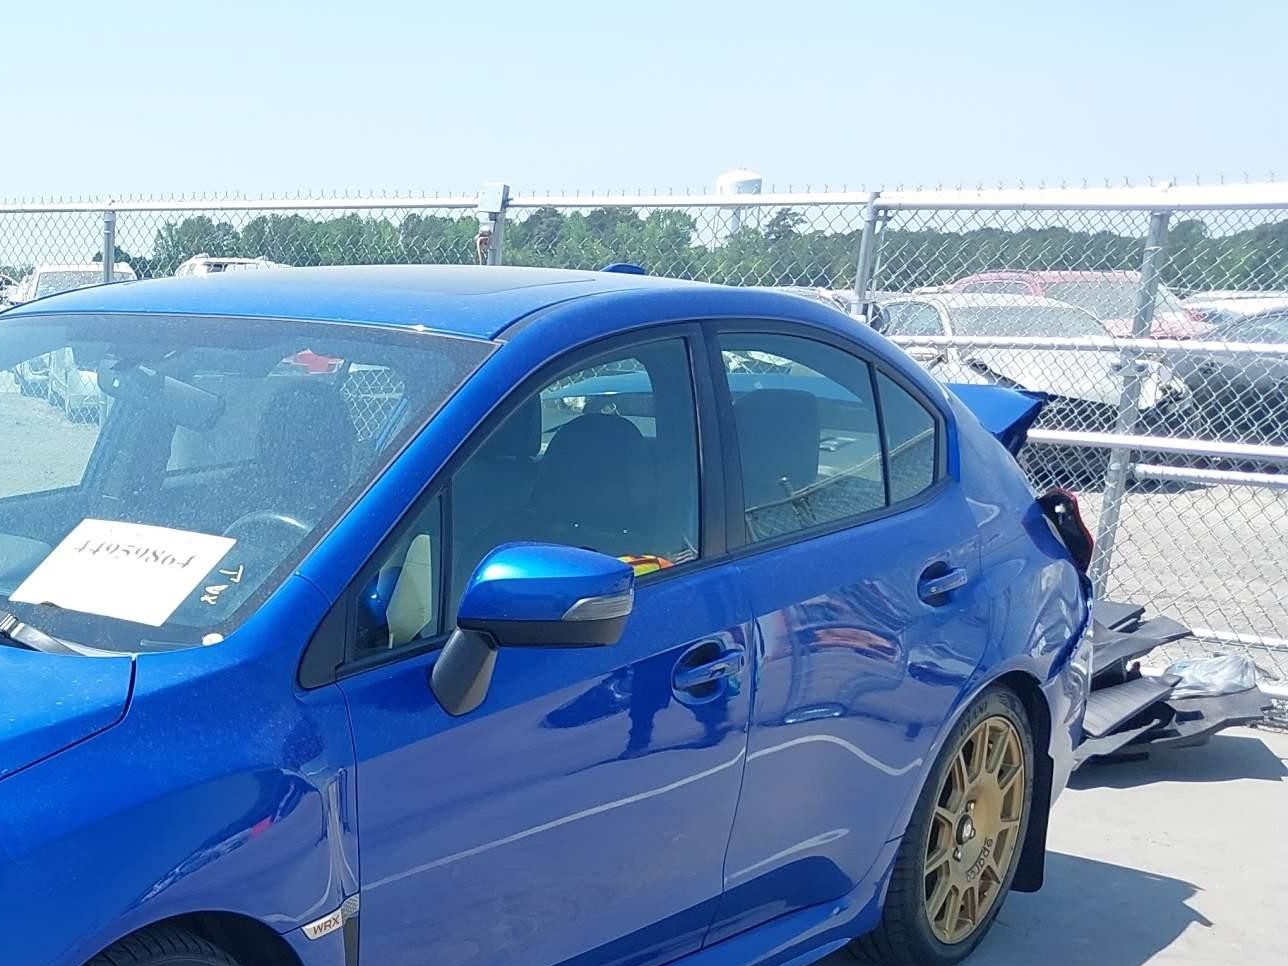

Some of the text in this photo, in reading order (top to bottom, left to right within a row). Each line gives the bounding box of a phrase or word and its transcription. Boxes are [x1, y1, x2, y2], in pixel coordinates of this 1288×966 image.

[73, 539, 197, 569] 44959864
[966, 837, 993, 882] sparco
[312, 914, 340, 936] WRX
